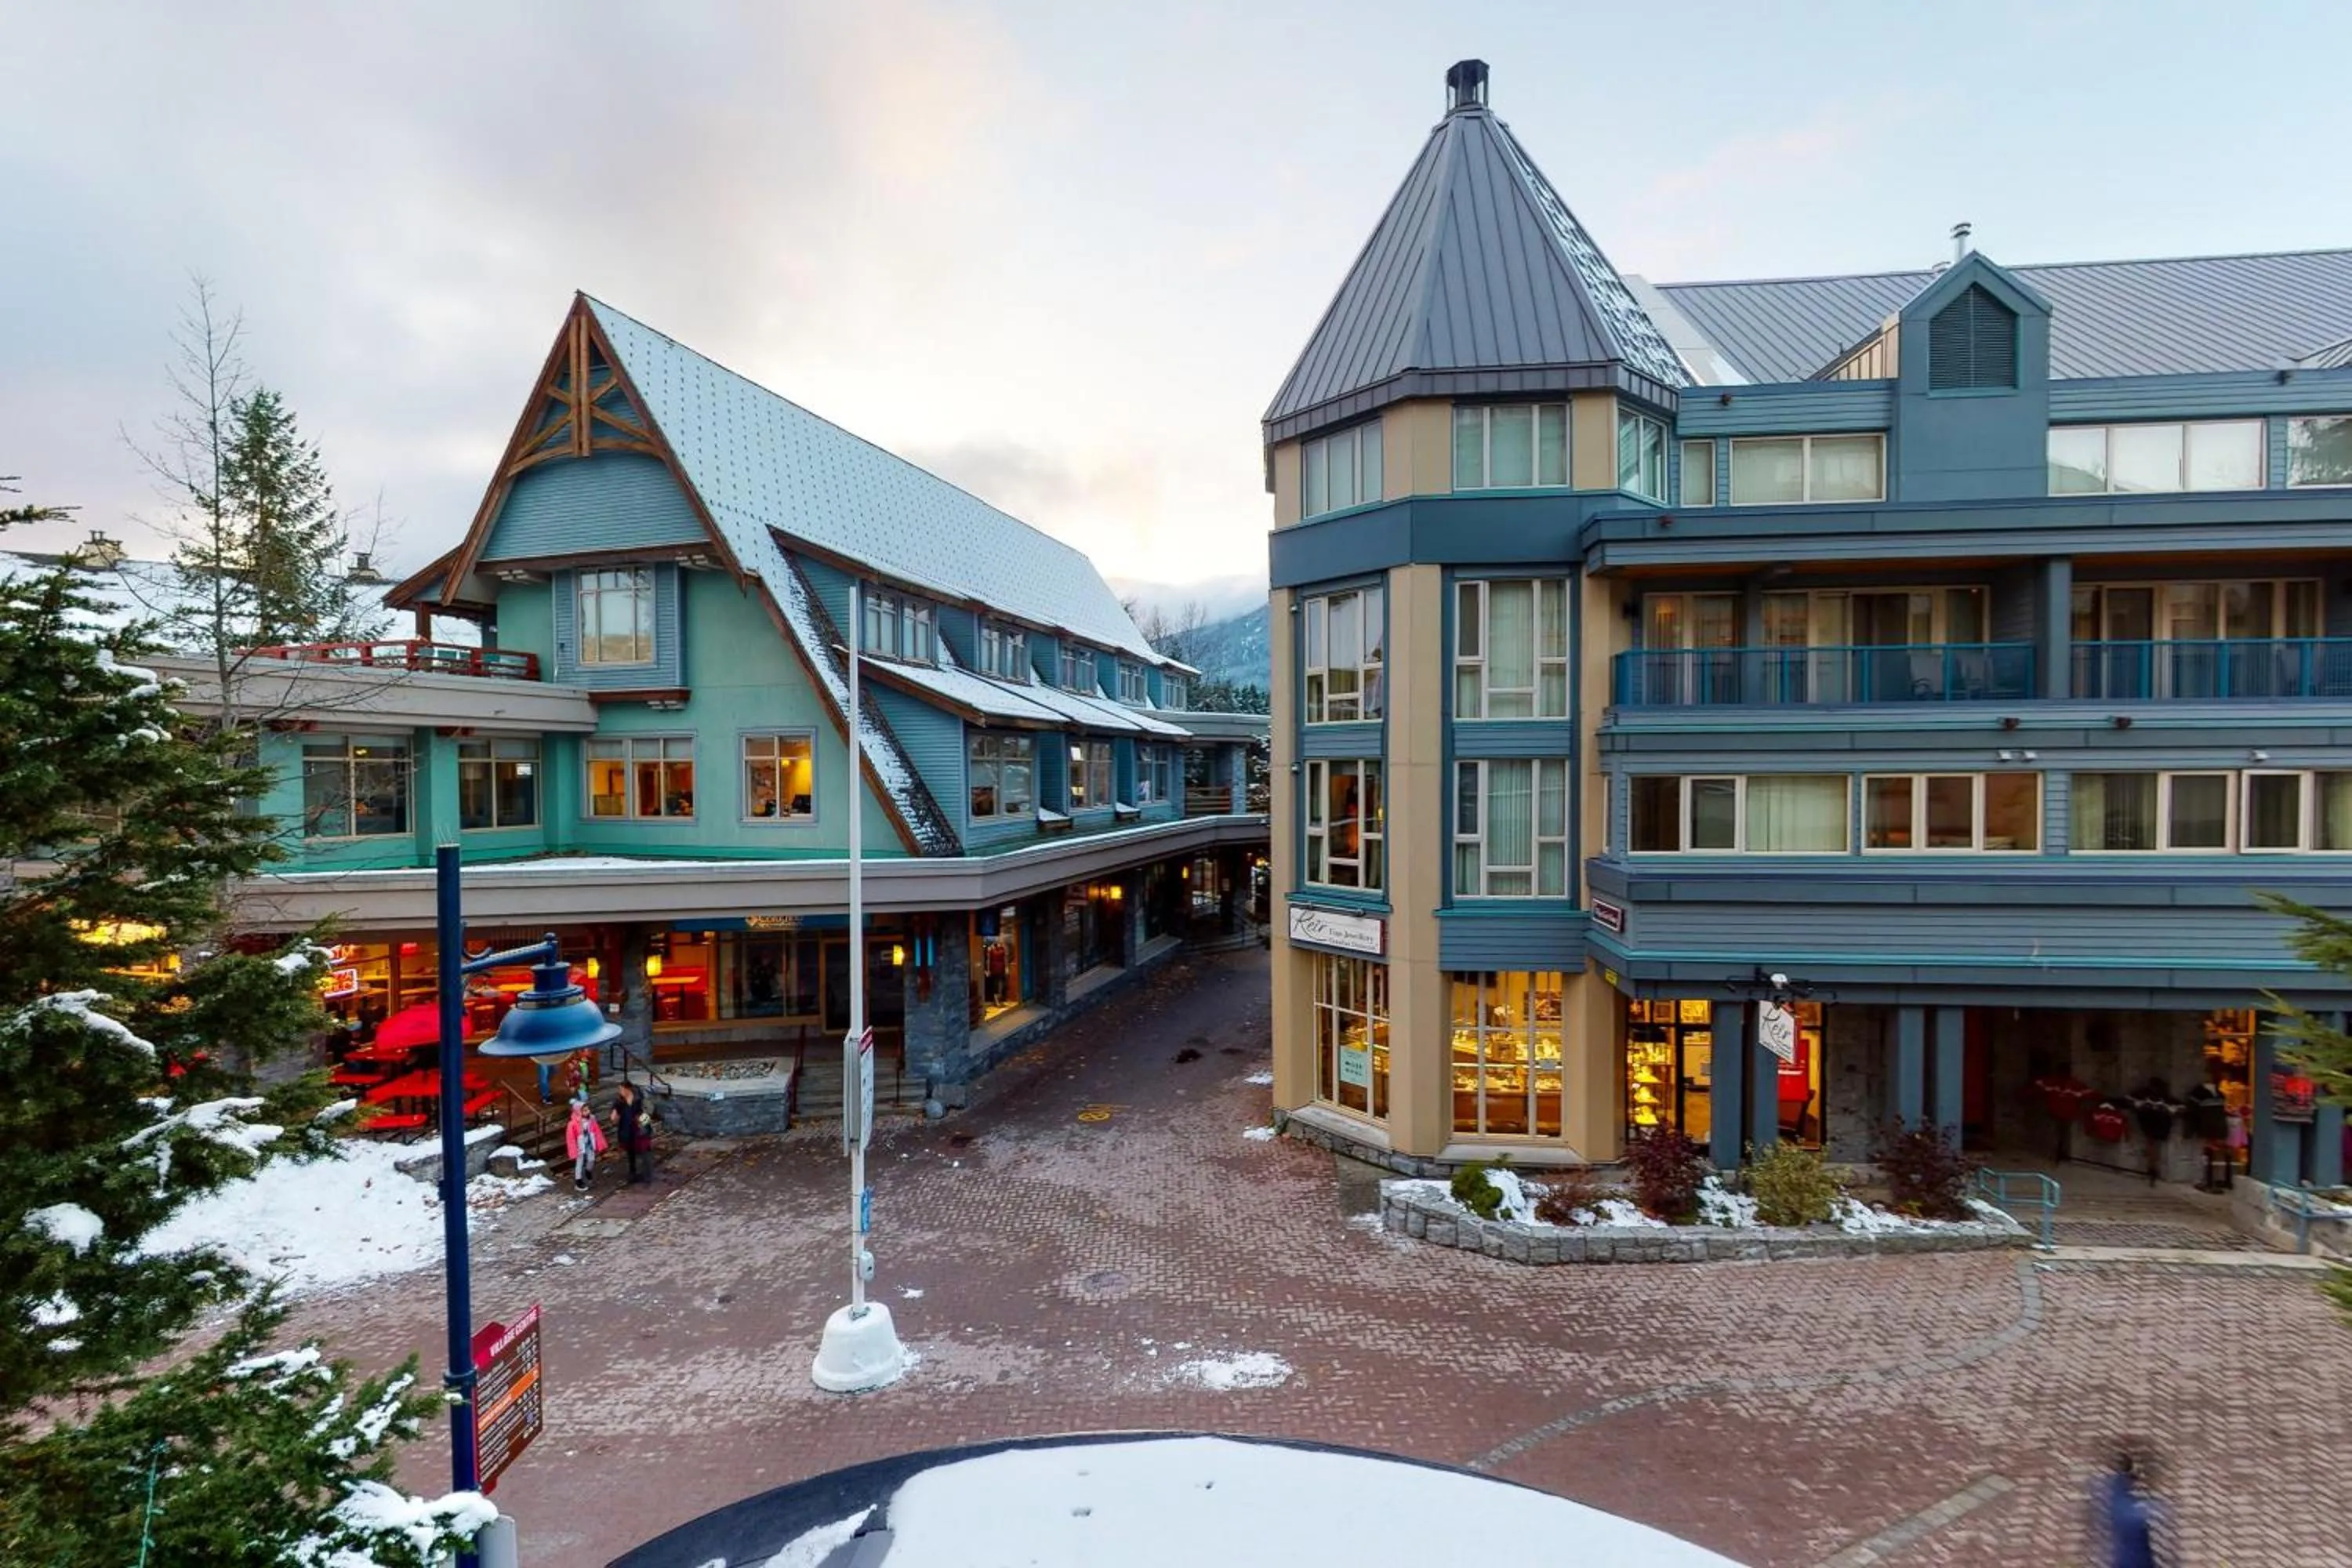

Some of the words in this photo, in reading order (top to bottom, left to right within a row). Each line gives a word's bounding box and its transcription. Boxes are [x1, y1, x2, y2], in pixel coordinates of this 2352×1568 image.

[1293, 910, 1327, 941] Keir
[1762, 1007, 1791, 1044] Keir
[489, 1328, 515, 1357] VILLAGE
